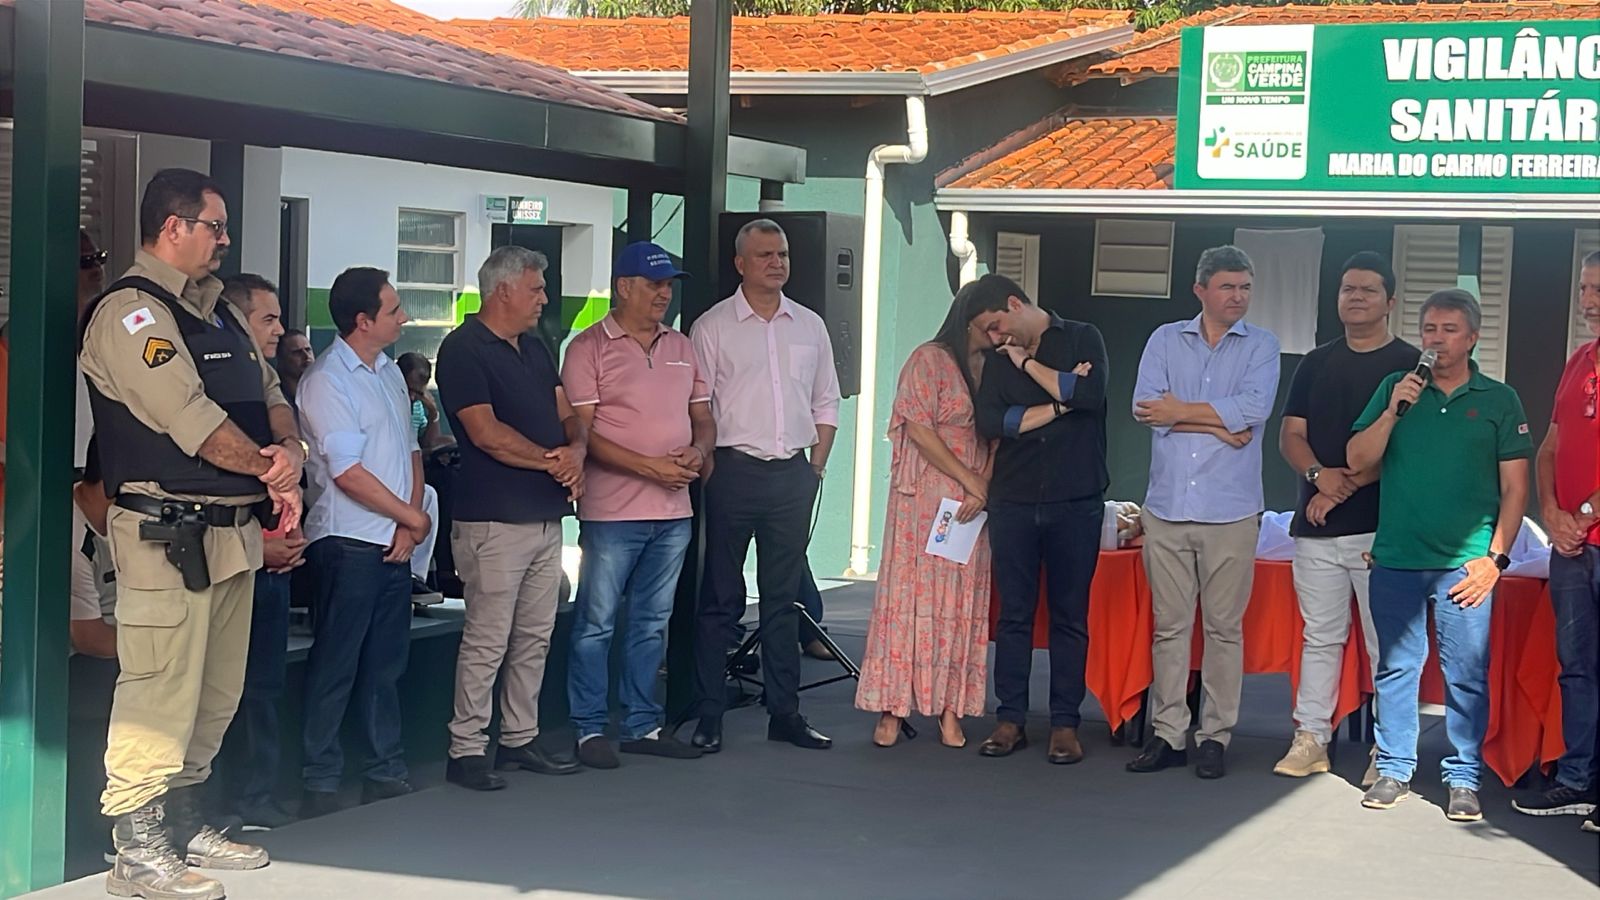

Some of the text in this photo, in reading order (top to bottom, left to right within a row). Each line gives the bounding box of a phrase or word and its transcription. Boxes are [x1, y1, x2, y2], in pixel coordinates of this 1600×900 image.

[1247, 55, 1303, 63] PREFEITURA
[1248, 63, 1303, 74] CAMPINA
[1247, 73, 1303, 88] VERDE
[1221, 96, 1291, 104] UM NOVO TEMPO
[1390, 89, 1600, 142] SANITÁR
[1234, 138, 1302, 158] SAÚDE
[1328, 153, 1600, 179] MARIA DO CARMO FERREIR
